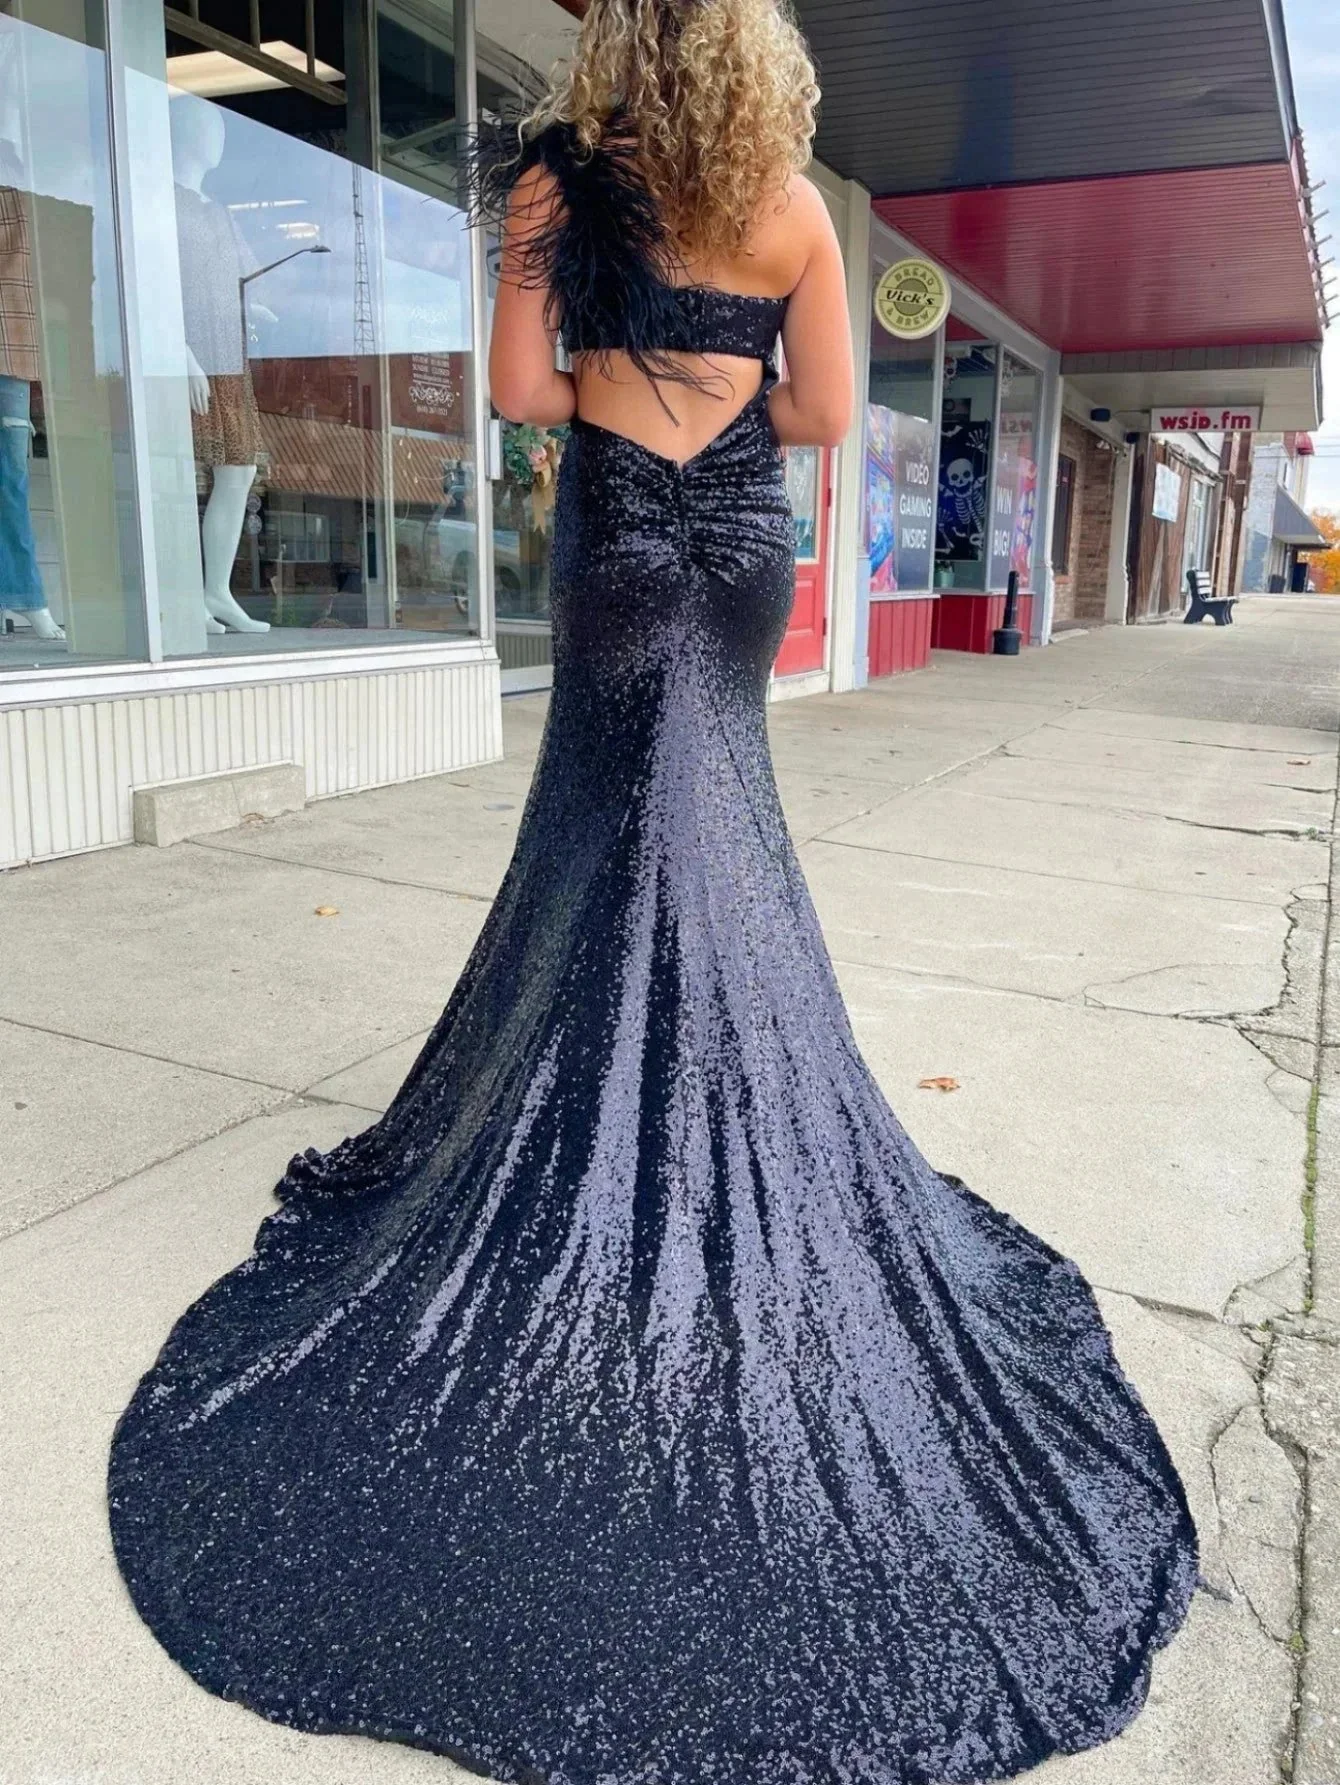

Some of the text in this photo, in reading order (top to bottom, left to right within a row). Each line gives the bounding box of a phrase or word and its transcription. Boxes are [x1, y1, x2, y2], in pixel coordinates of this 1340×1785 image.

[894, 267, 934, 286] BREAD
[886, 289, 935, 306] Vick's
[896, 310, 929, 326] BREW
[905, 460, 930, 486] VIDEO
[899, 493, 932, 518] GAMING
[996, 485, 1013, 515] WIN
[901, 527, 928, 550] INSIDE
[993, 529, 1010, 557] BIG!
